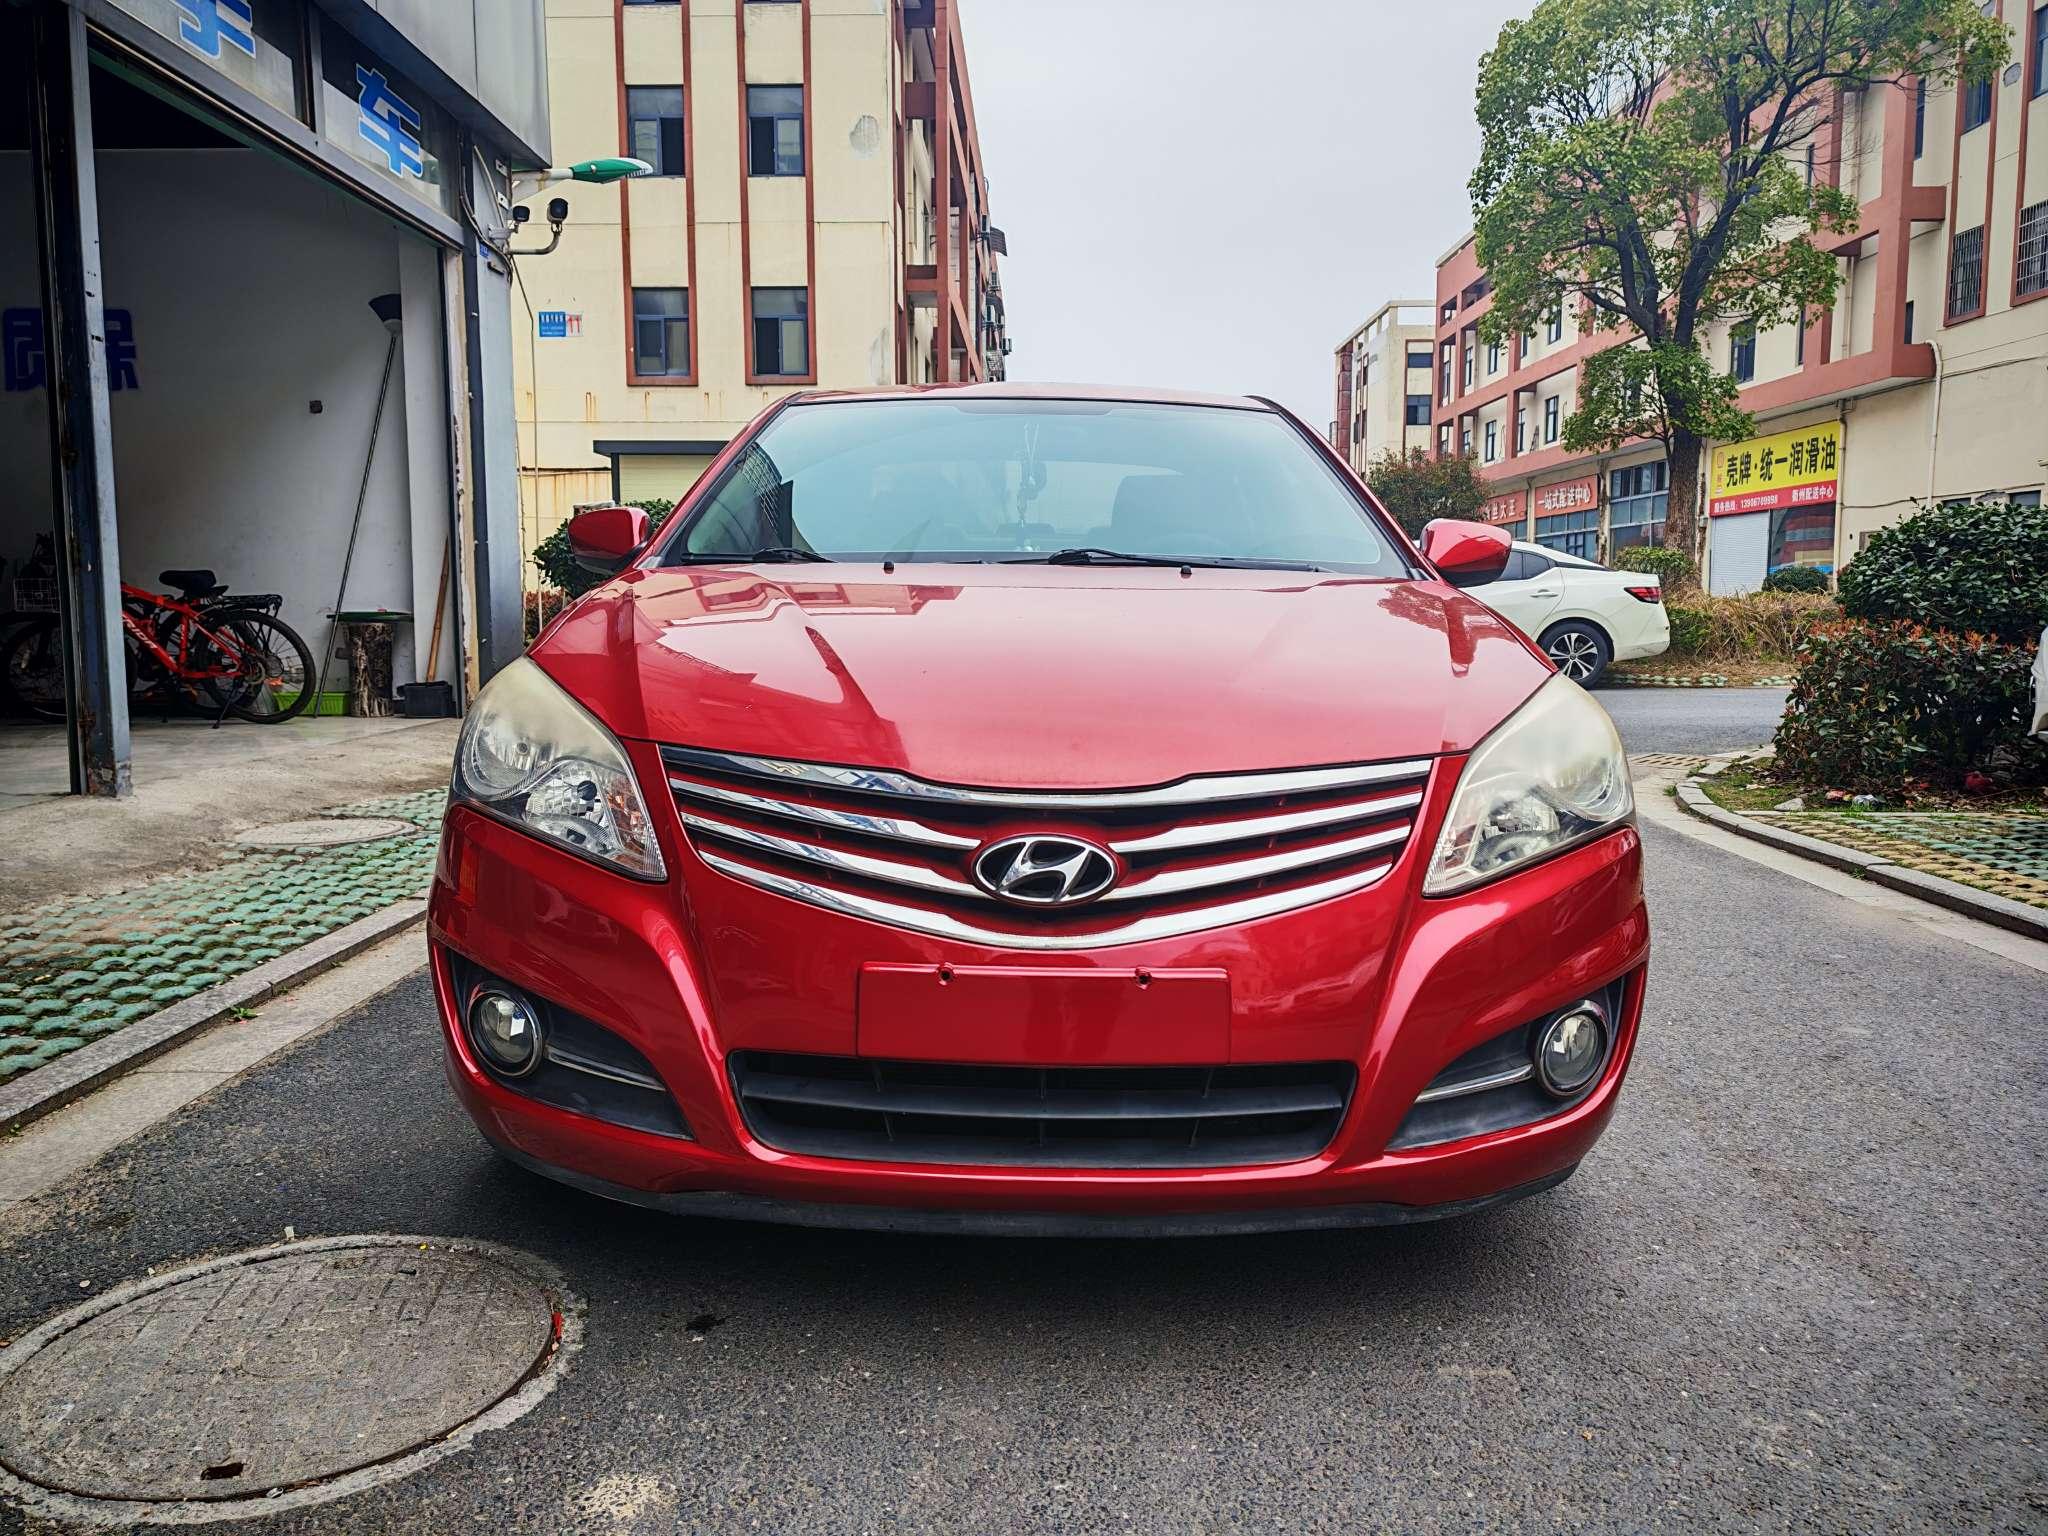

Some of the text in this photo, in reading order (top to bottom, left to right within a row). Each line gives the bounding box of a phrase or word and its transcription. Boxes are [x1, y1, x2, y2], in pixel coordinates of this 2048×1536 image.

[1537, 482, 1592, 511] 一站式配送中心
